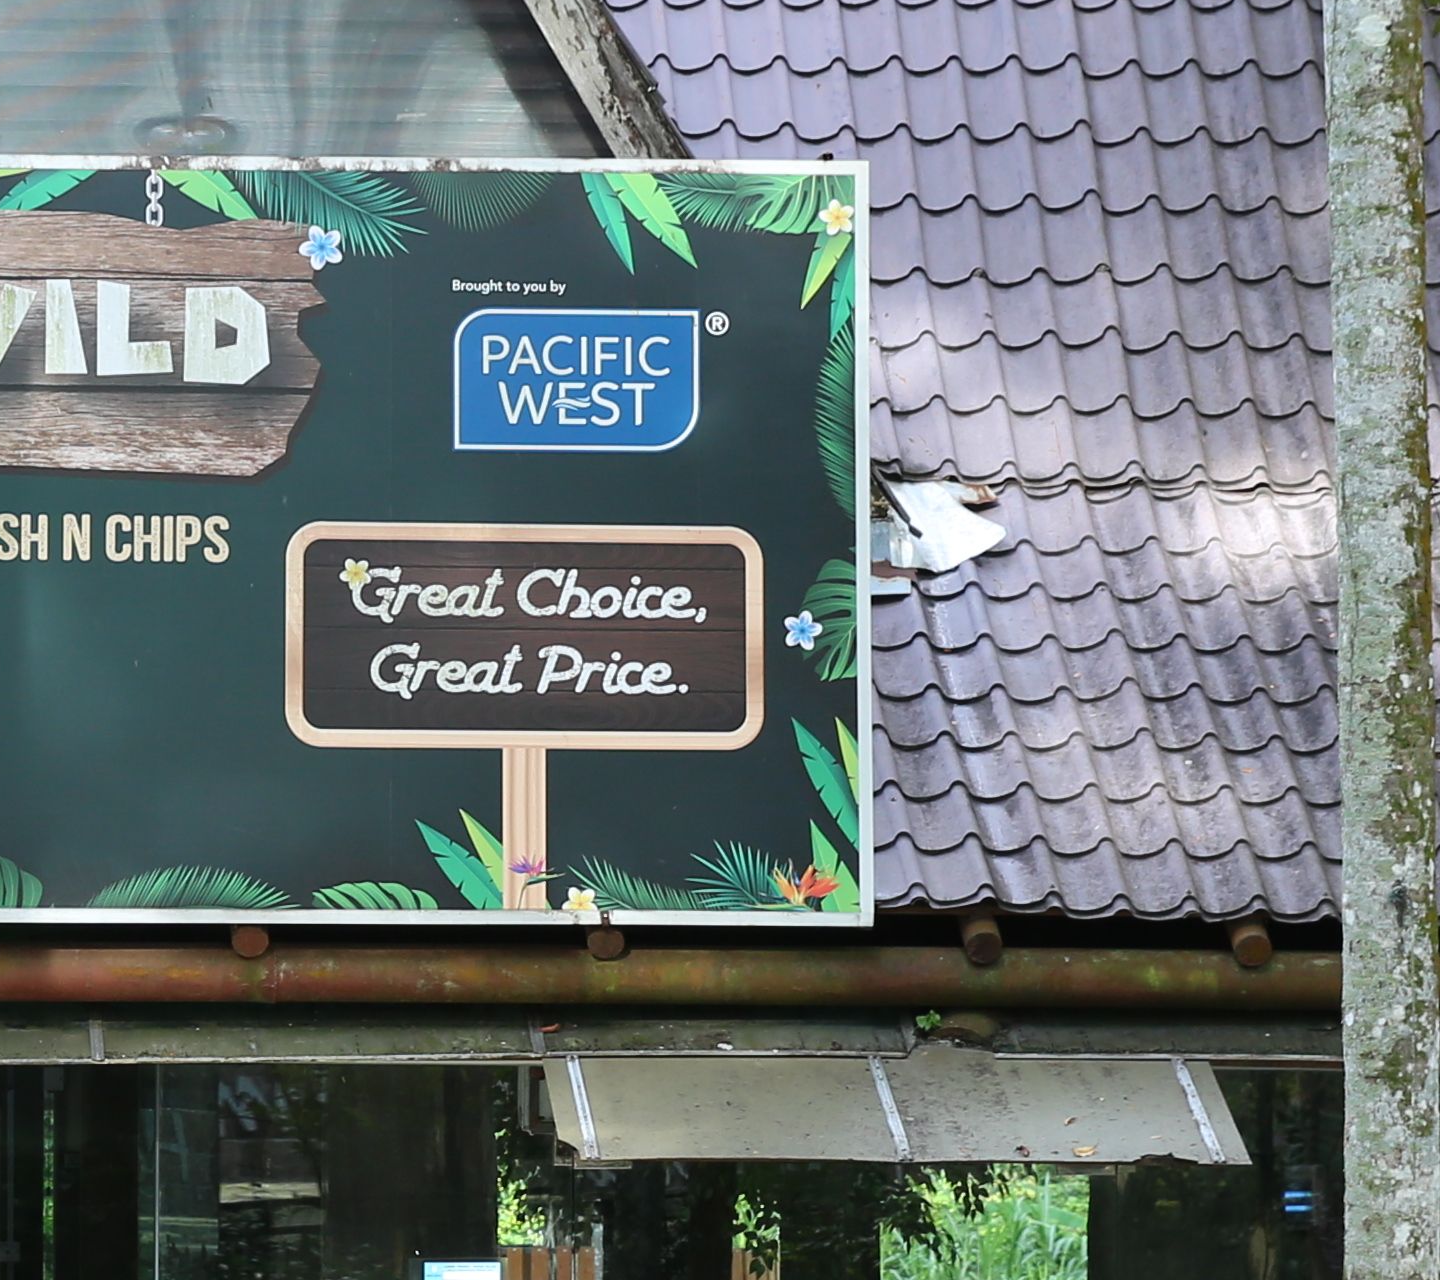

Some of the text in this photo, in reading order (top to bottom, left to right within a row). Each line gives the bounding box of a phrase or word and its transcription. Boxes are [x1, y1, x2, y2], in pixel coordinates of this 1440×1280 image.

[452, 279, 566, 295] Brought to you by
[481, 334, 671, 377] PACIFIC
[498, 381, 656, 427] WEST
[62, 513, 92, 562] N
[105, 514, 231, 564] CHIPS
[351, 566, 709, 623] Great Choice,
[369, 642, 690, 700] Great Price.
